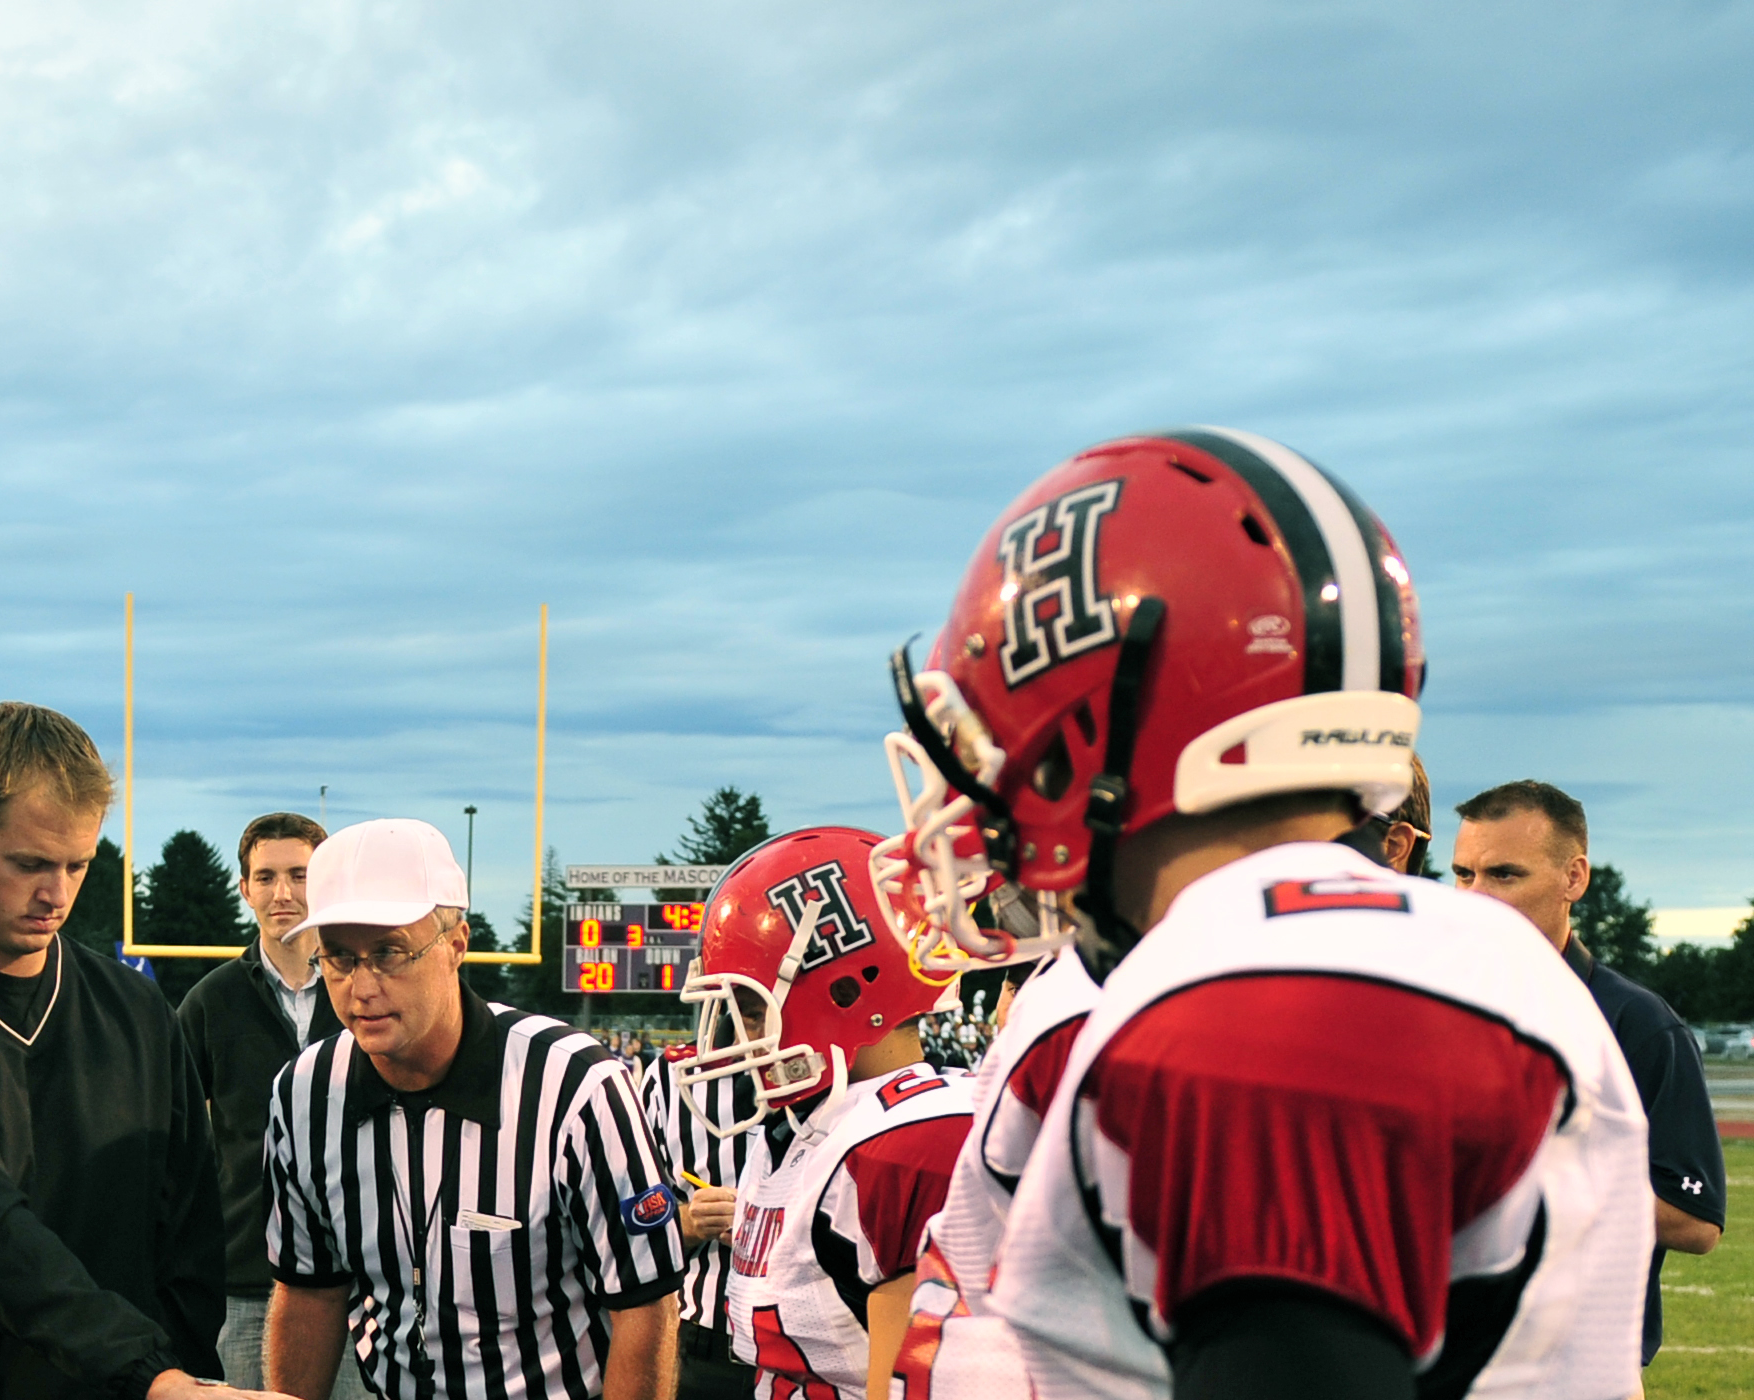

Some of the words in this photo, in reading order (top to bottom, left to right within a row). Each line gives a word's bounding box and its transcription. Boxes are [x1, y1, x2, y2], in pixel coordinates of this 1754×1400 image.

[996, 479, 1126, 692] H
[569, 870, 609, 883] HOME
[612, 871, 630, 883] OF
[634, 872, 660, 883] THE
[663, 870, 726, 884] MASCO
[570, 905, 622, 921] INDIANS
[765, 859, 877, 974] H
[579, 918, 602, 949] 0
[627, 924, 644, 949] 3
[579, 962, 615, 992] 20
[661, 964, 674, 991] 1
